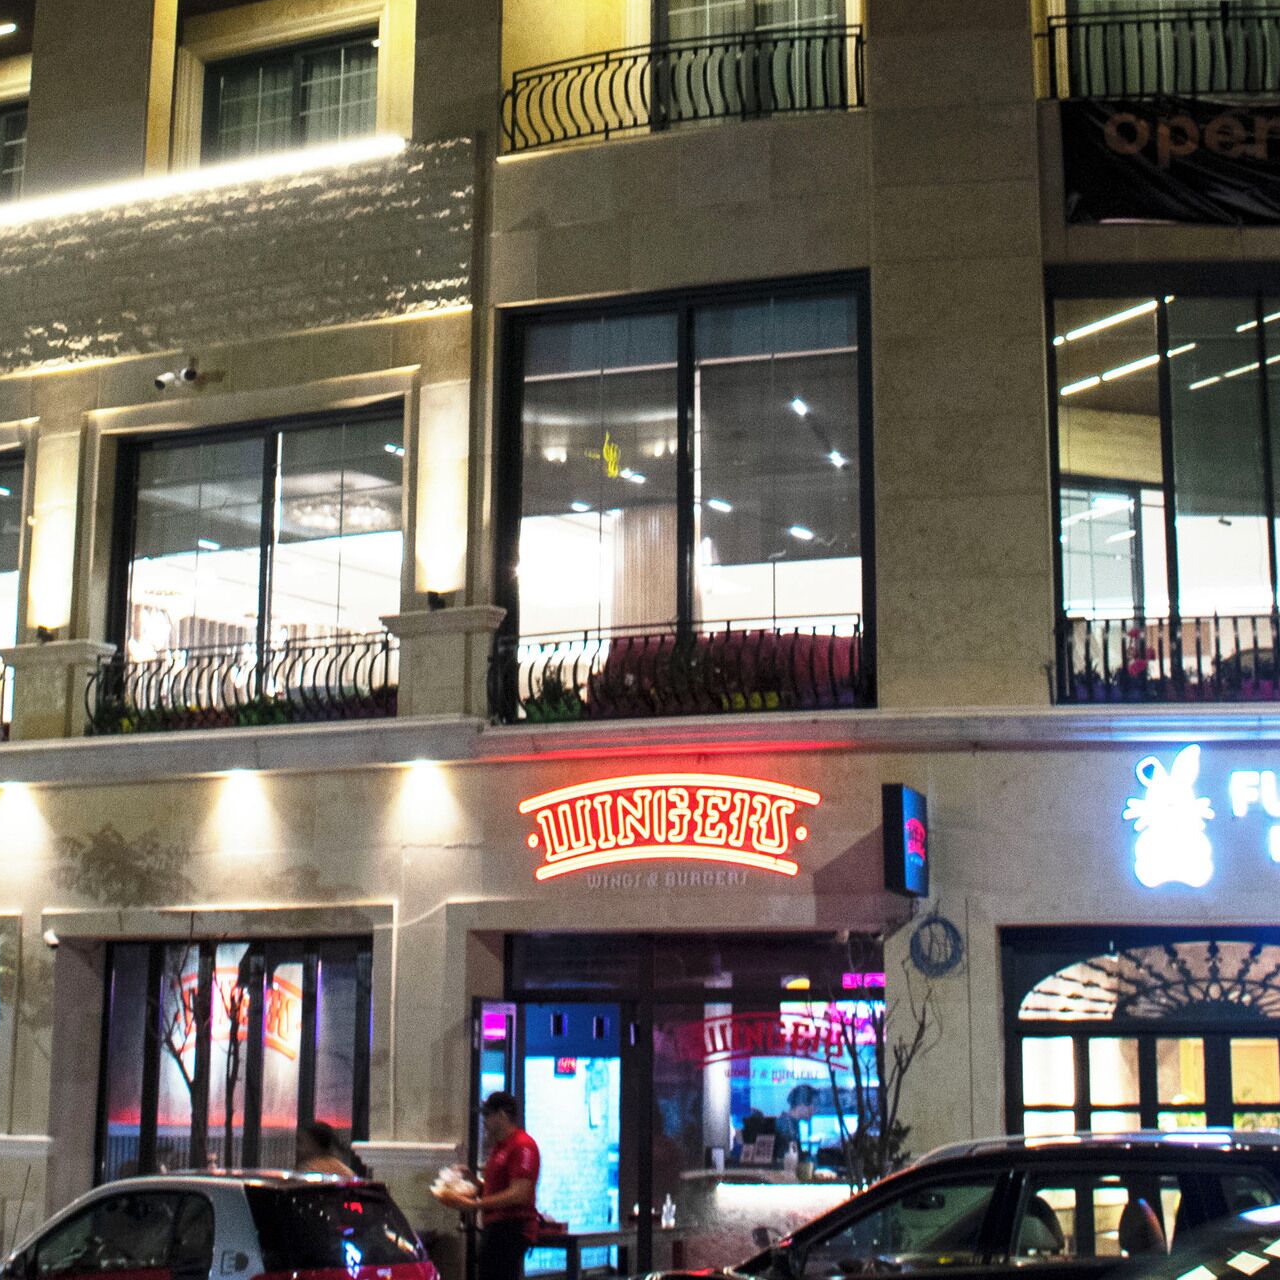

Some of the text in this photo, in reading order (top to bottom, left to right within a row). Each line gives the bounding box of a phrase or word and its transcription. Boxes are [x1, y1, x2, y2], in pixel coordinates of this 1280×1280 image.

[536, 787, 796, 863] WINGERS
[586, 871, 642, 889] WINGS
[664, 869, 749, 888] BURGERS
